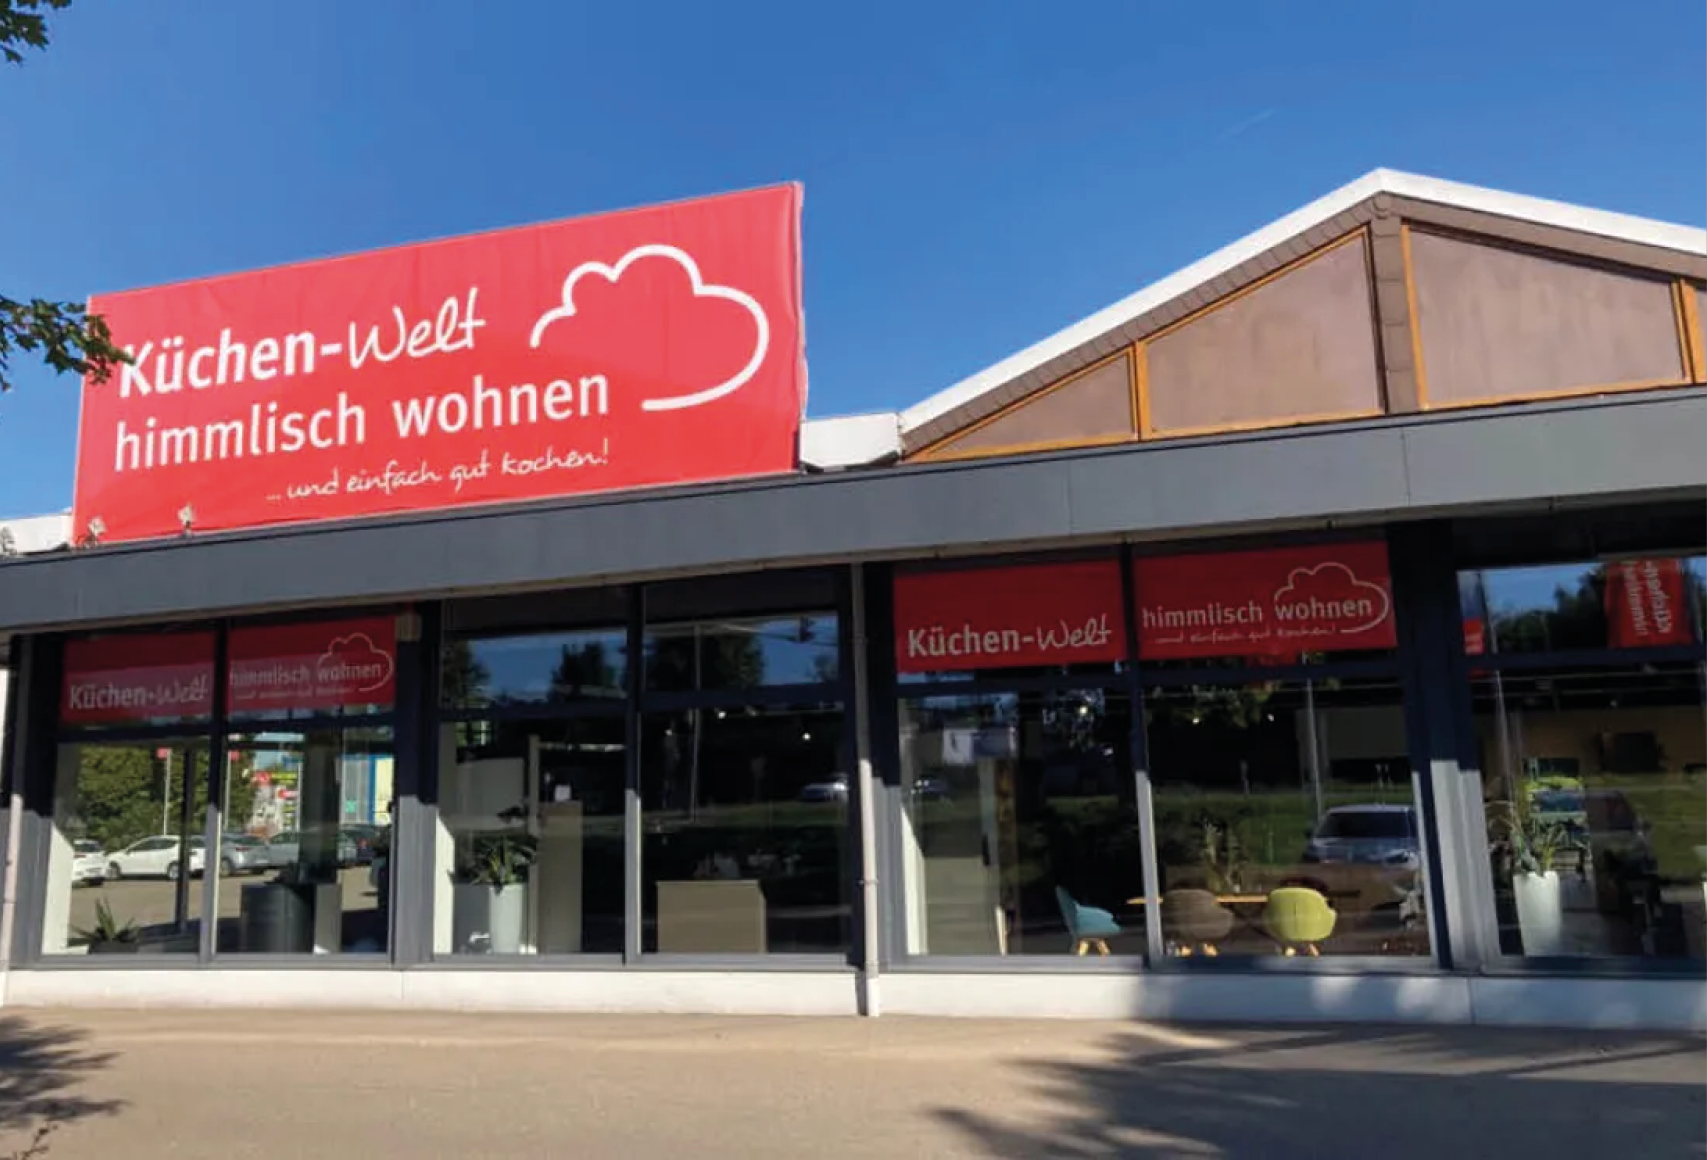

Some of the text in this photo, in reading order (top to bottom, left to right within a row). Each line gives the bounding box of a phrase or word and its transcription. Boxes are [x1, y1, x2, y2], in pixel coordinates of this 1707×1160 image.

[119, 286, 486, 398] Küchen-Welt
[114, 373, 609, 472] himmlisch wohnen
[347, 459, 442, 495] einfach
[449, 449, 491, 492] gut
[502, 437, 609, 476] kochen!
[907, 612, 1113, 658] Küchen-Welt
[1142, 597, 1373, 629] himmlisch wohnen
